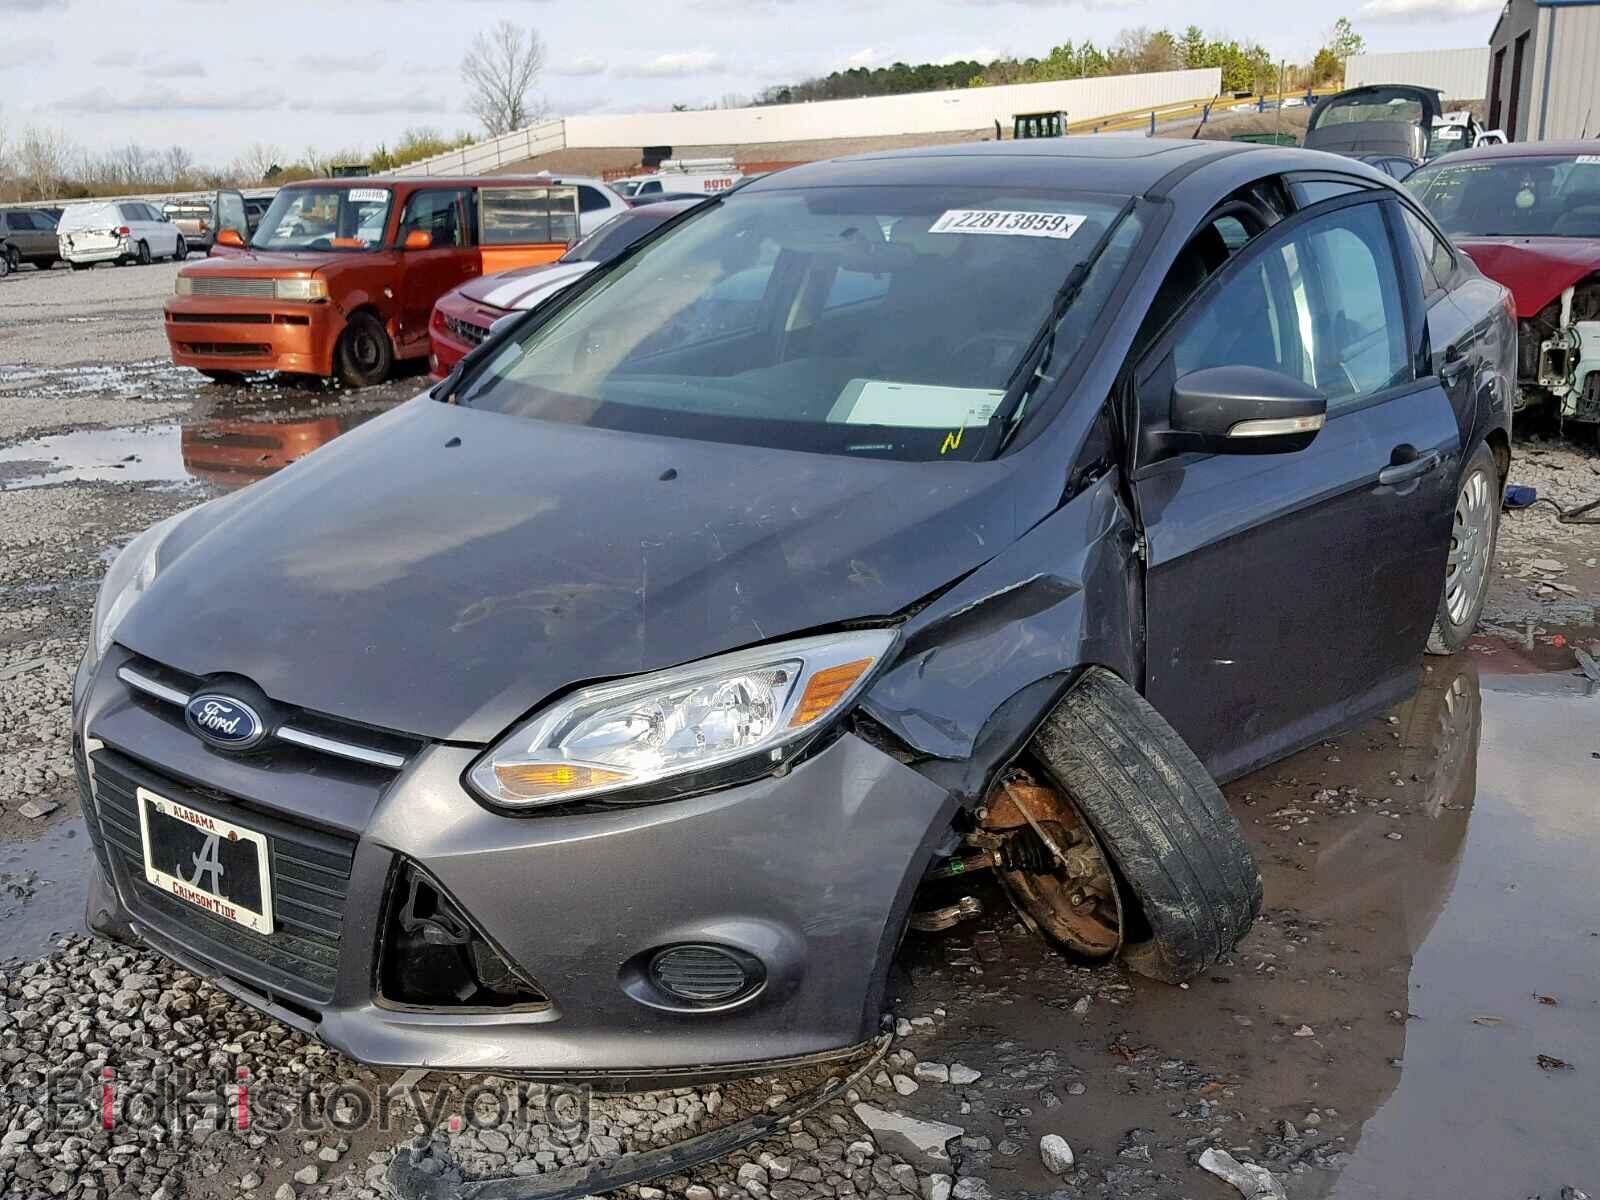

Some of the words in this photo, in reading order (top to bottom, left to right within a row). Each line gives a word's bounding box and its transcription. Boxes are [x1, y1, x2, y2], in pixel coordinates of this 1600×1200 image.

[704, 178, 733, 189] ROTO
[198, 701, 241, 735] Ford
[173, 806, 217, 832] ALABAMA
[172, 881, 214, 909] CRIMSON
[213, 900, 237, 920] TIDE
